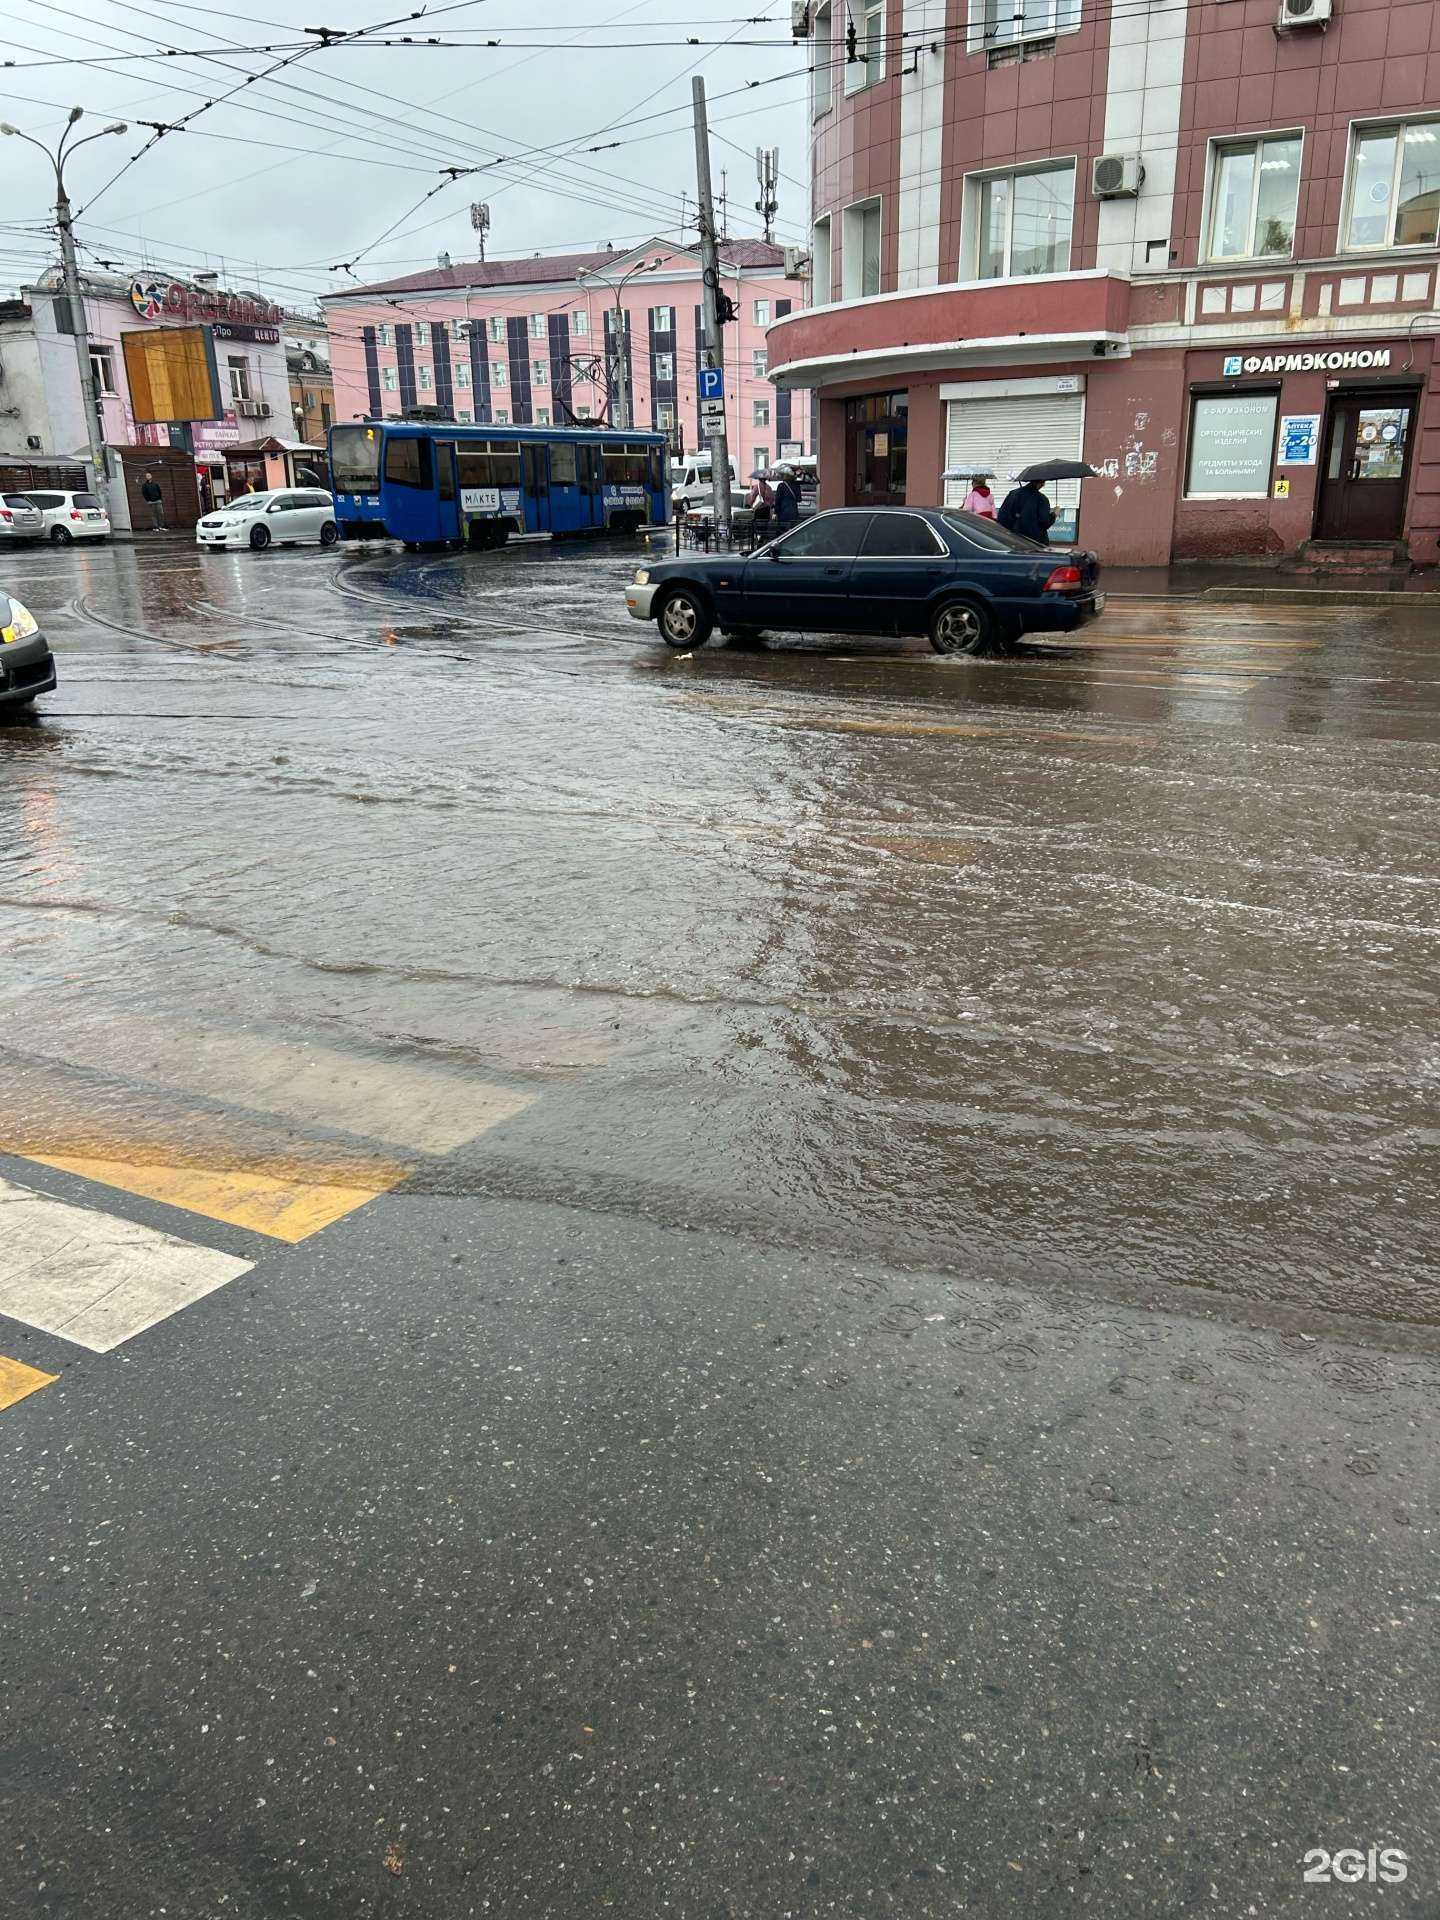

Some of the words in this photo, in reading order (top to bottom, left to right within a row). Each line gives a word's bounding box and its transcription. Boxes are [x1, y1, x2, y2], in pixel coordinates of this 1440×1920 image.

[1243, 349, 1391, 373] ФАРМЭКОНОМ
[705, 372, 718, 396] P
[1198, 460, 1237, 468] ПРЕДМЕТЫ
[1239, 459, 1263, 467] УХОДА
